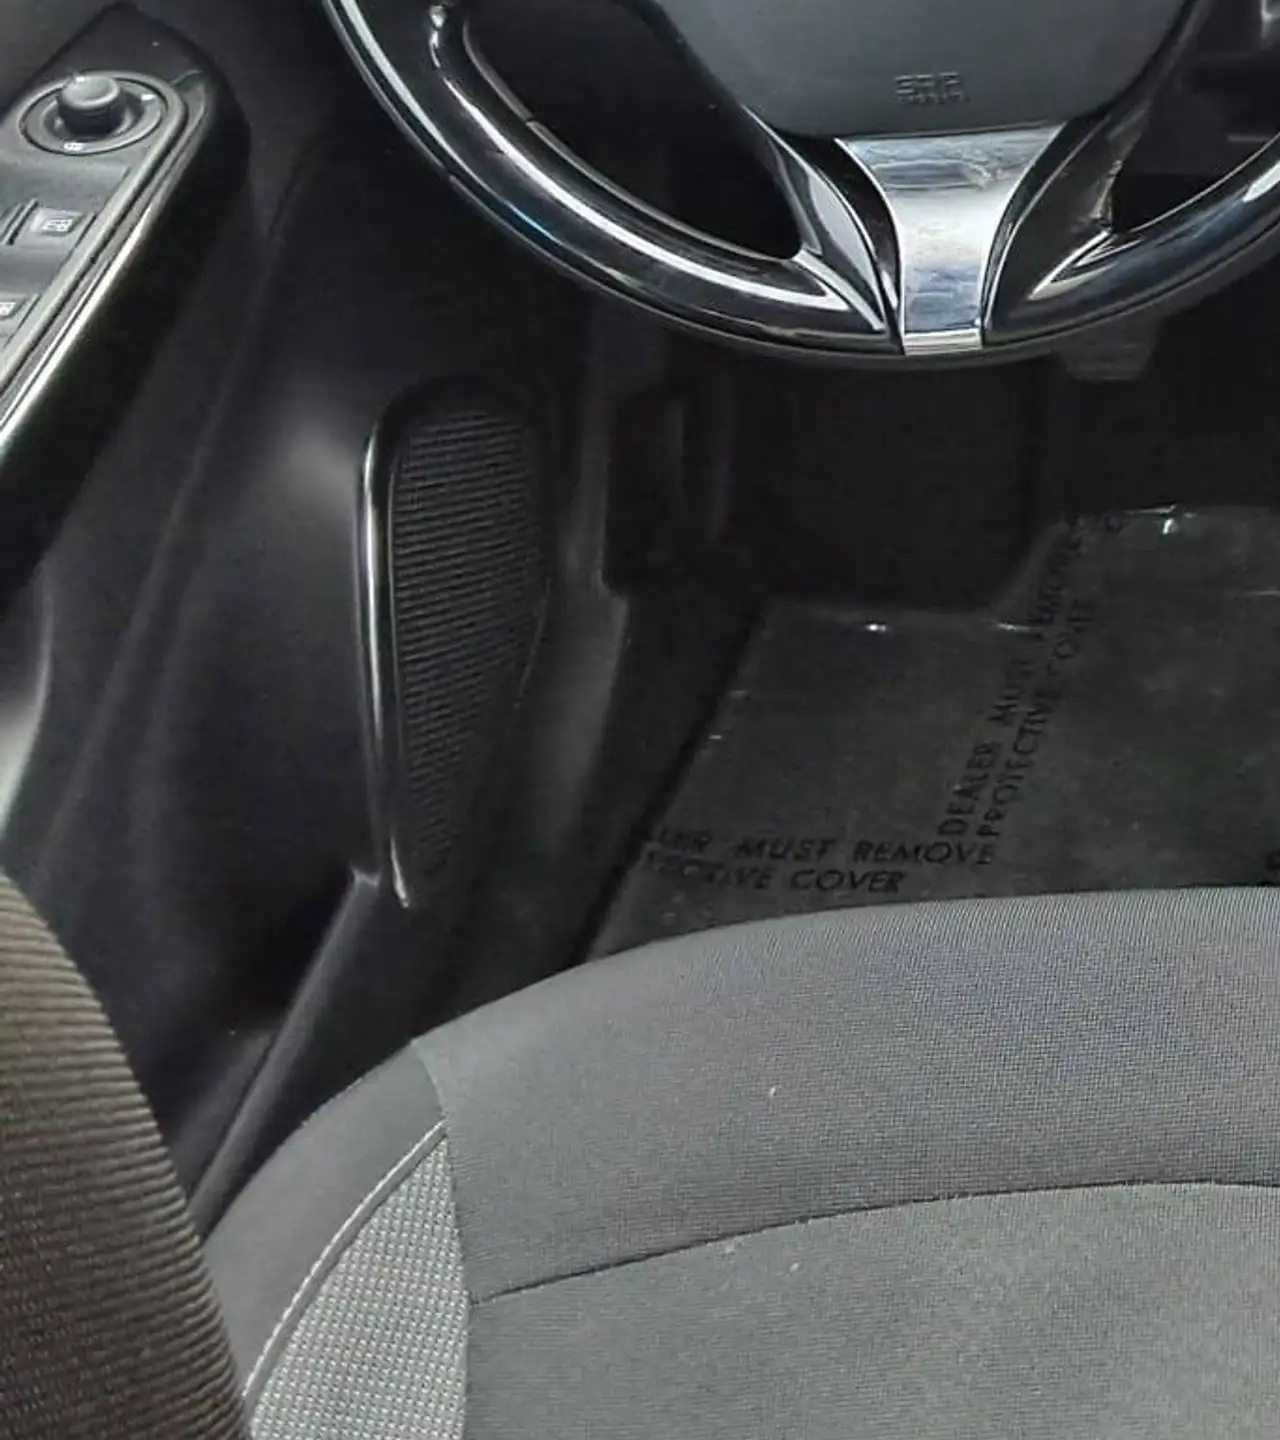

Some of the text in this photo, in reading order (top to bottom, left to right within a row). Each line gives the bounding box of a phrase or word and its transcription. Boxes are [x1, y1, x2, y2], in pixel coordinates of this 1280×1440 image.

[937, 741, 1002, 837] DEALER
[733, 837, 837, 861] MUST
[852, 839, 1000, 866] REMOVE
[789, 868, 908, 894] COVER
